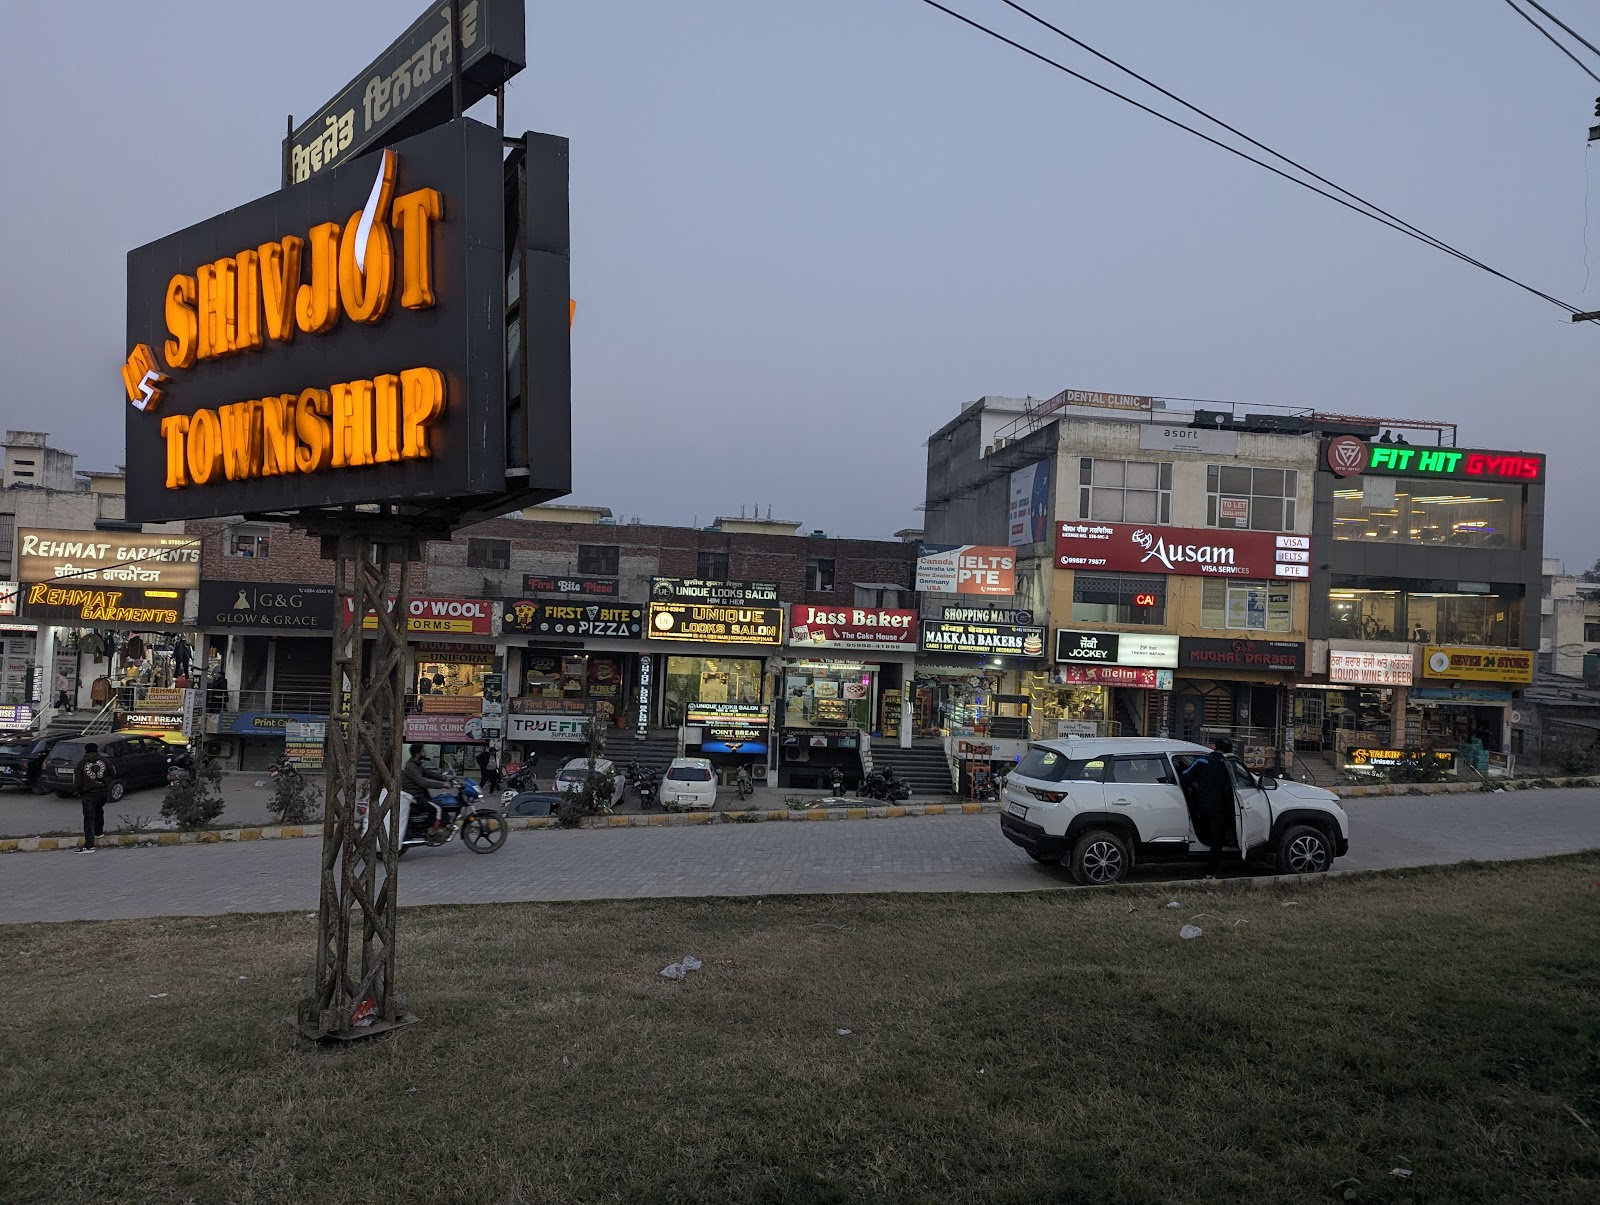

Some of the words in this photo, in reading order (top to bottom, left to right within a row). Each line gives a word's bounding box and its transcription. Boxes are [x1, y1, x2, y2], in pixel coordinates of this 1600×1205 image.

[165, 149, 443, 368] SHIVJOT
[1067, 391, 1105, 404] DENTAL
[1107, 395, 1140, 407] CLINIC
[161, 366, 445, 488] TOWNSHIP
[1164, 429, 1198, 439] asort
[1370, 447, 1415, 470] FIT
[1418, 451, 1463, 473] HIT
[1465, 454, 1540, 479] GYMS
[22, 535, 112, 559] REHMAT
[117, 547, 201, 563] GARMENTS
[1283, 539, 1303, 547] VISA
[1140, 535, 1235, 570] Ausam
[1281, 552, 1303, 560] IELTS
[921, 558, 954, 566] Canada
[959, 556, 1013, 570] IELTS
[959, 570, 1000, 585] PTE
[1218, 566, 1250, 574] SERVICES
[1284, 567, 1300, 575] PTE
[528, 578, 555, 590] First
[557, 580, 581, 592] Bite
[583, 581, 613, 593] Pizza
[675, 586, 710, 598] UNIQUE
[712, 588, 743, 598] LOOKS
[744, 589, 777, 600] SALON
[29, 583, 123, 608] REHMAT
[260, 593, 302, 608] G&G
[81, 606, 178, 624] GARMENTS
[216, 613, 257, 623] GLOW
[260, 615, 270, 624] &
[273, 615, 318, 625] GRACE
[544, 606, 584, 619] FIRST
[600, 609, 631, 622] BITE
[692, 607, 765, 624] UNIQUE
[806, 607, 846, 625] Jass
[852, 609, 912, 628] Baker
[944, 608, 990, 622] SHOPPING
[990, 610, 1016, 623] MART
[578, 621, 630, 636] PIZZA
[681, 622, 726, 634] LOOKS
[731, 623, 776, 637] SALON
[841, 631, 855, 639] The
[856, 632, 874, 640] Cake
[875, 632, 898, 641] House
[926, 631, 976, 645] MAKKAR
[977, 634, 1023, 648] BAKERS
[431, 653, 487, 663] UNIFORM
[1069, 649, 1108, 659] JOCKEY
[1190, 650, 1241, 662] MUGHAL
[1243, 653, 1297, 665] DARBAR
[1451, 654, 1482, 667] SEVEN
[1483, 656, 1496, 668] 24
[1497, 657, 1530, 669] STORE
[1101, 667, 1137, 679] Melini
[1330, 668, 1359, 681] LIQUOR
[1361, 670, 1382, 682] WINE
[1384, 671, 1390, 683] &
[1392, 671, 1412, 683] BEER
[154, 715, 183, 723] BREAK
[254, 718, 275, 727] Print
[440, 724, 464, 732] CLINIC
[1370, 758, 1395, 766] Unisex
